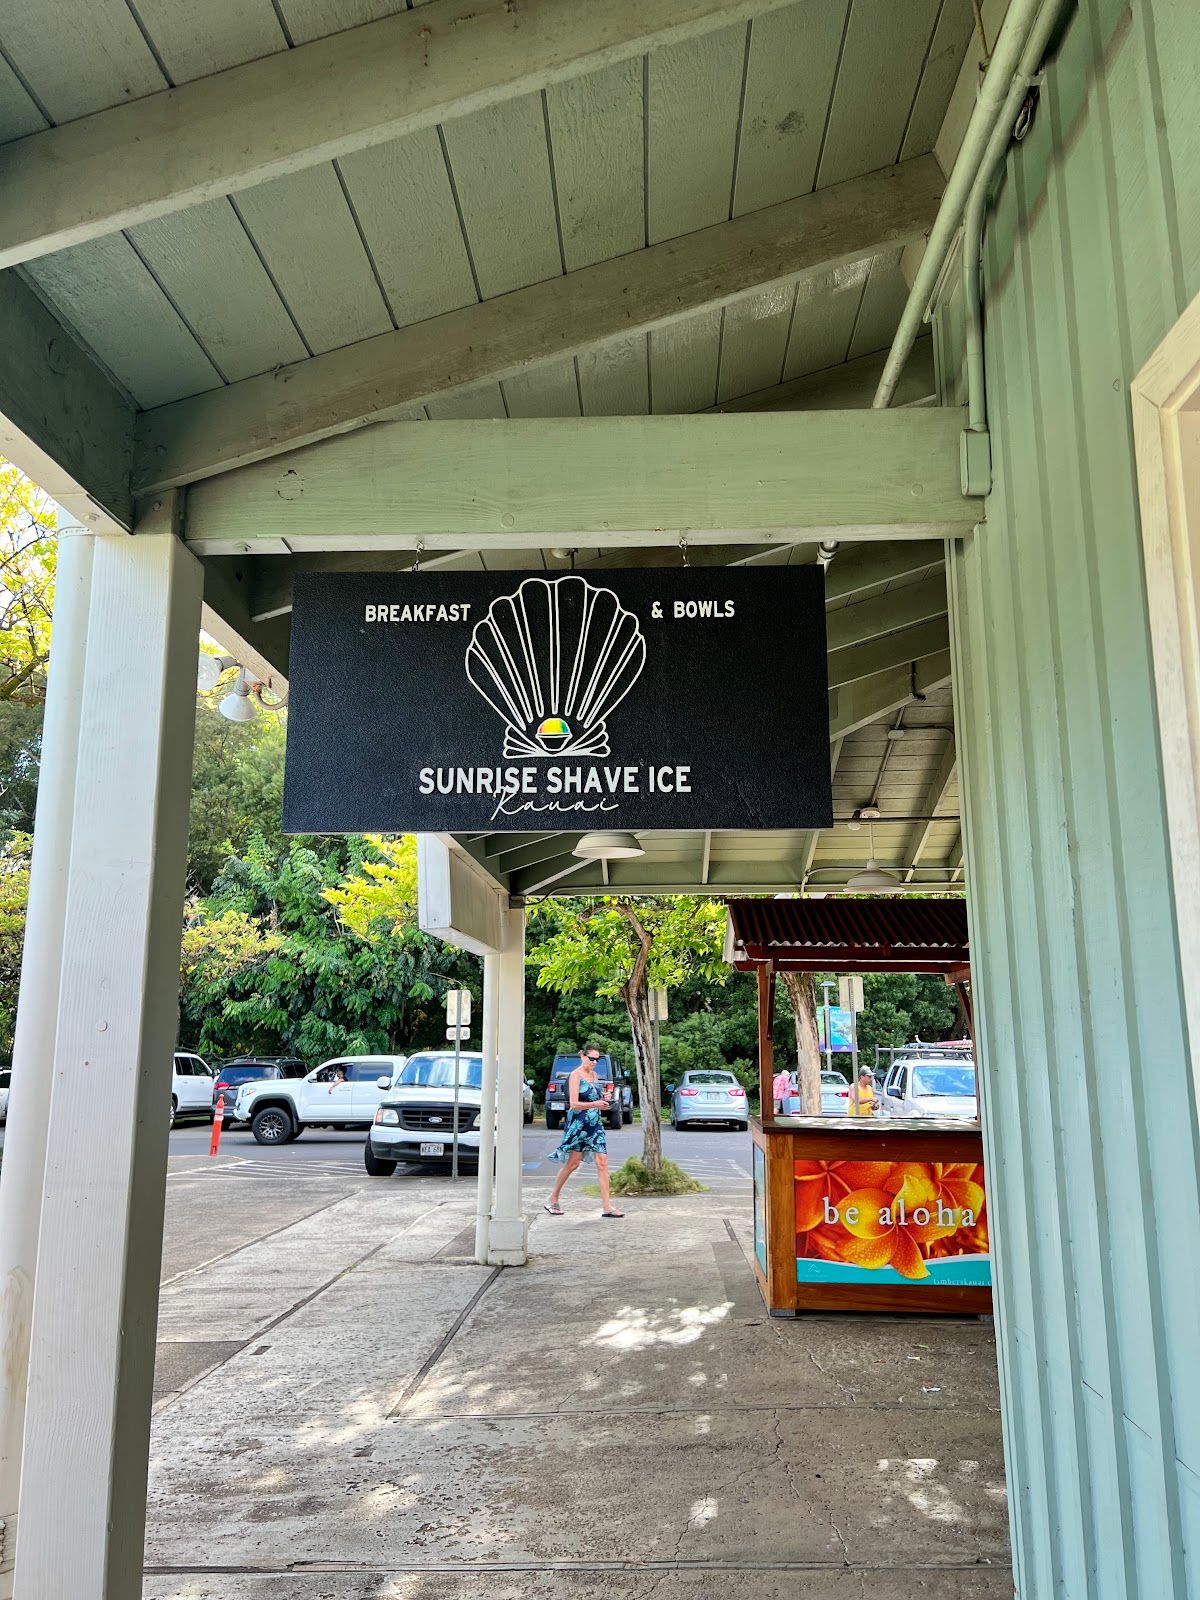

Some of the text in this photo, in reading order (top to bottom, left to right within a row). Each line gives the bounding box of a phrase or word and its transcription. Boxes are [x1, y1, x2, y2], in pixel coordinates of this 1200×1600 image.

[365, 603, 471, 622] BREAKFAST
[651, 600, 735, 619] & BOWLS
[418, 766, 692, 794] SUNRISE SHAVE ICE
[490, 786, 619, 821] Kauai
[822, 1197, 977, 1227] be aloha
